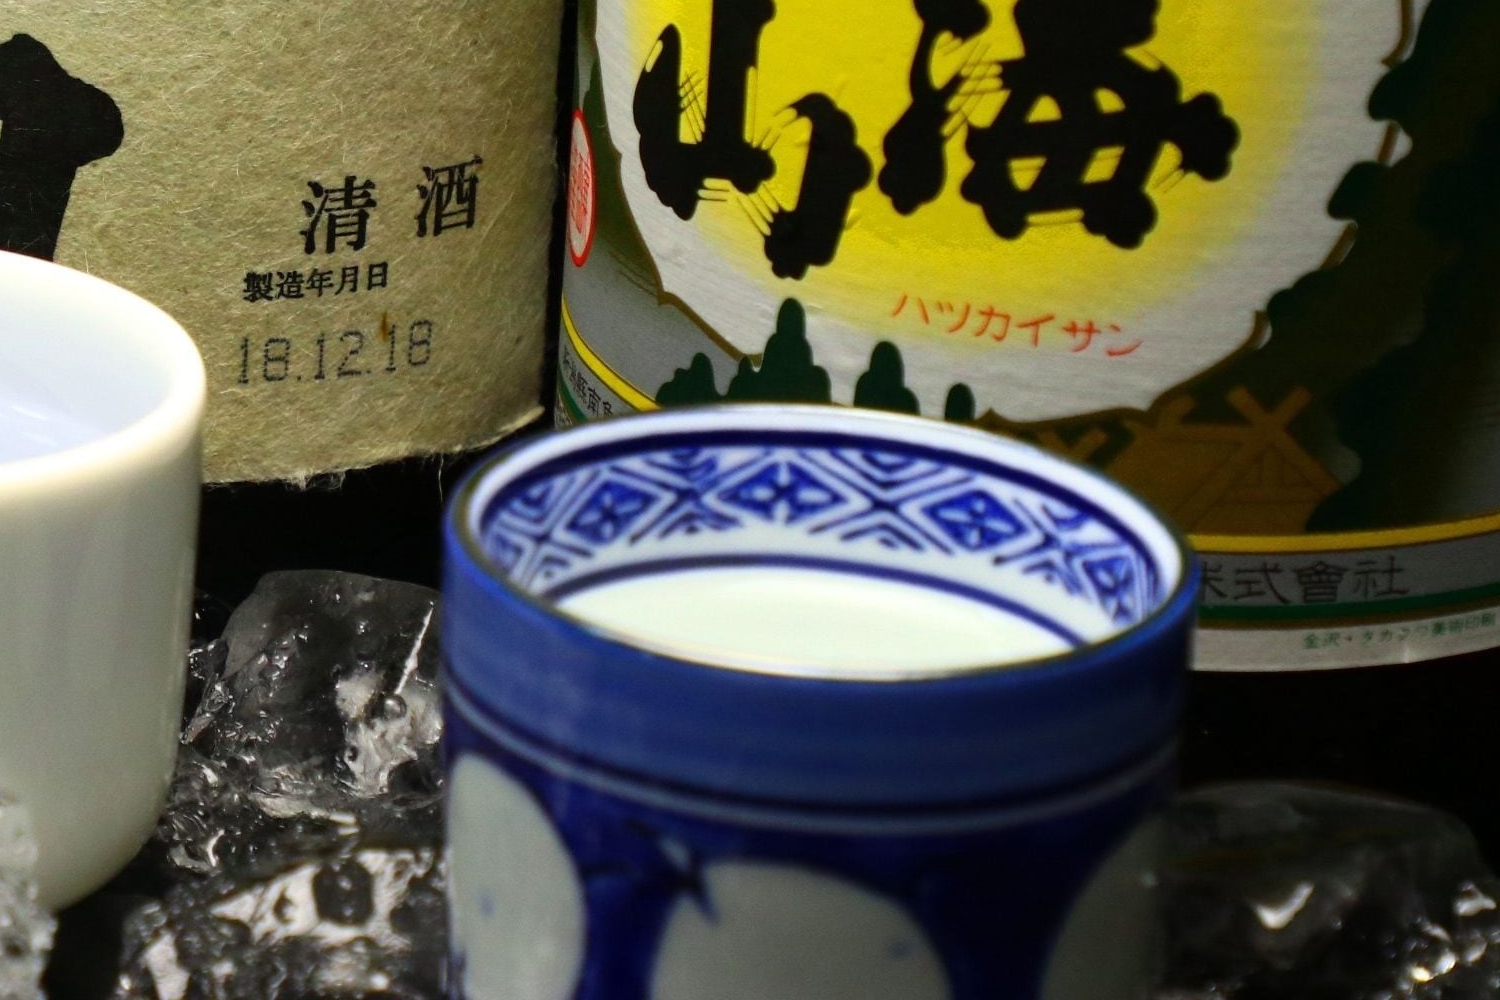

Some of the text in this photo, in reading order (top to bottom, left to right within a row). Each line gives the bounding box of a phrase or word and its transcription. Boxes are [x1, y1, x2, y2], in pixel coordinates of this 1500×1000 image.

[300, 155, 483, 254] 清酒
[243, 261, 389, 303] 製造年月日
[237, 319, 434, 385] 18.12.18
